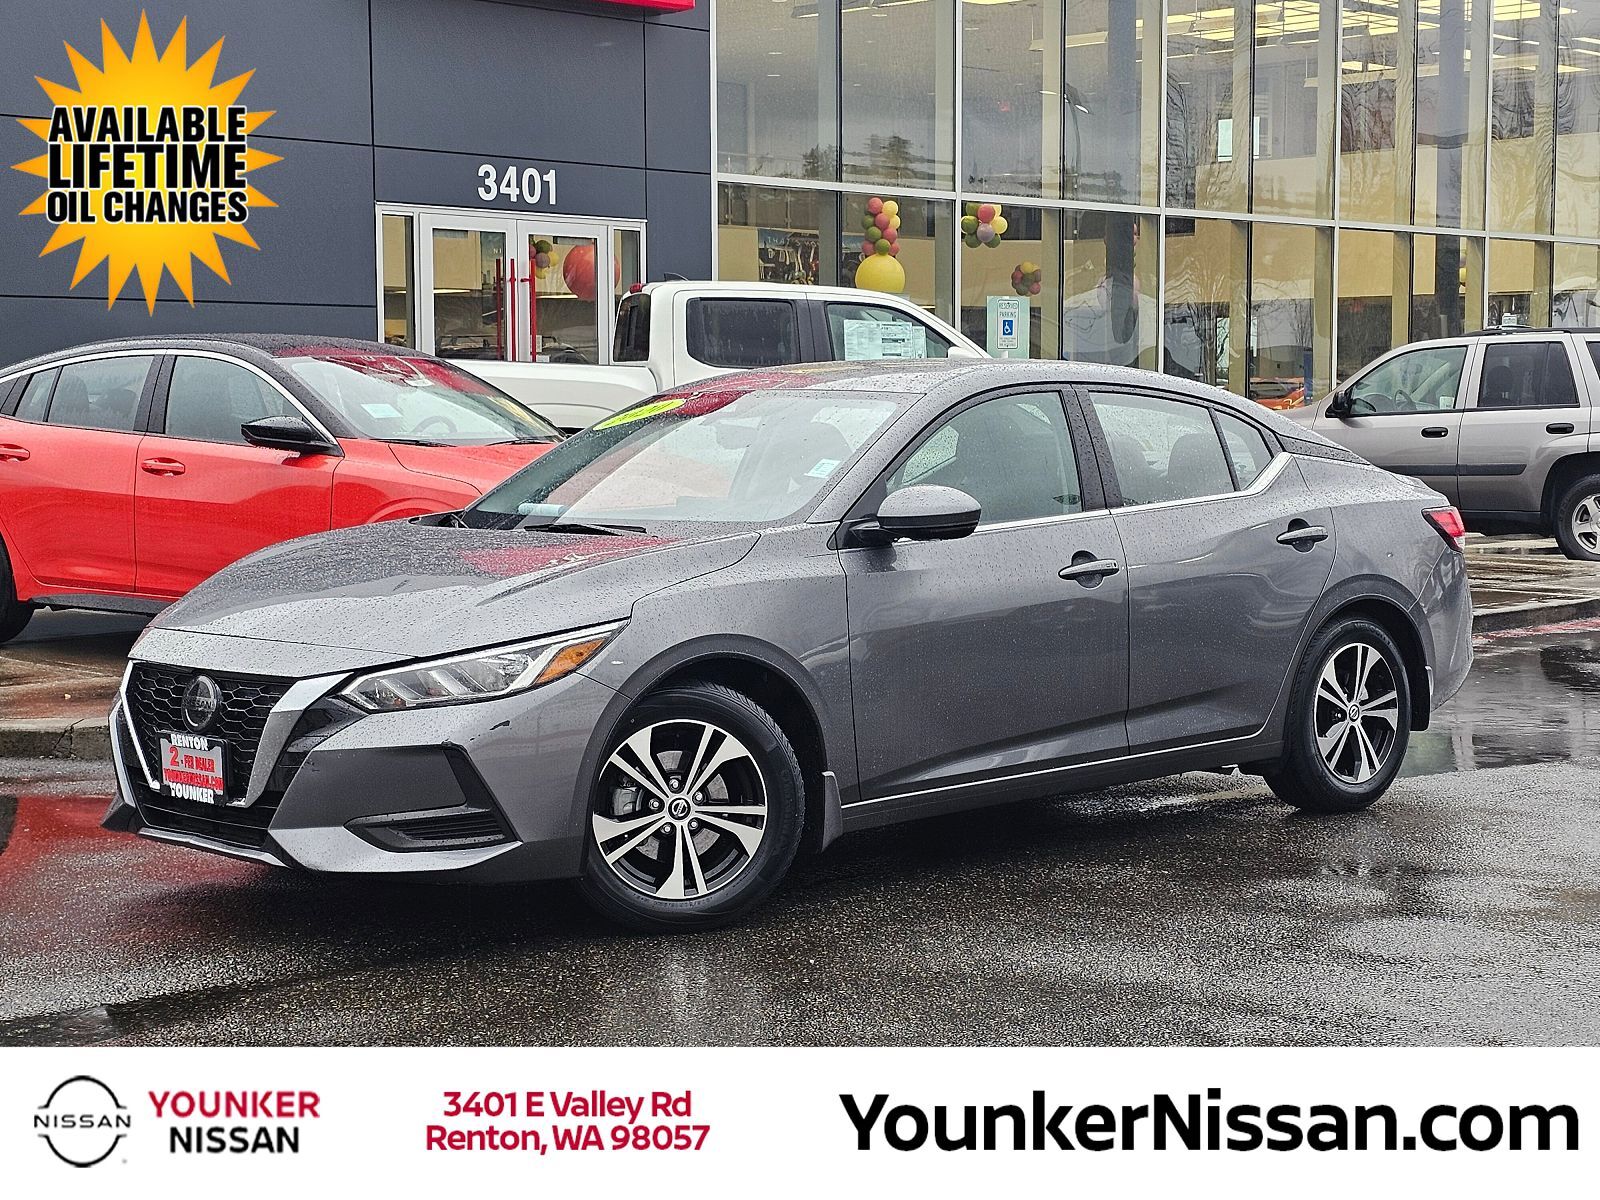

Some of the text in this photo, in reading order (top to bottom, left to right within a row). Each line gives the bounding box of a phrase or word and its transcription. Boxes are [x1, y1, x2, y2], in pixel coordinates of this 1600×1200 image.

[477, 164, 556, 205] 3401
[999, 311, 1017, 319] PARKING
[170, 733, 209, 751] RENTON
[169, 782, 215, 804] YOUNKER
